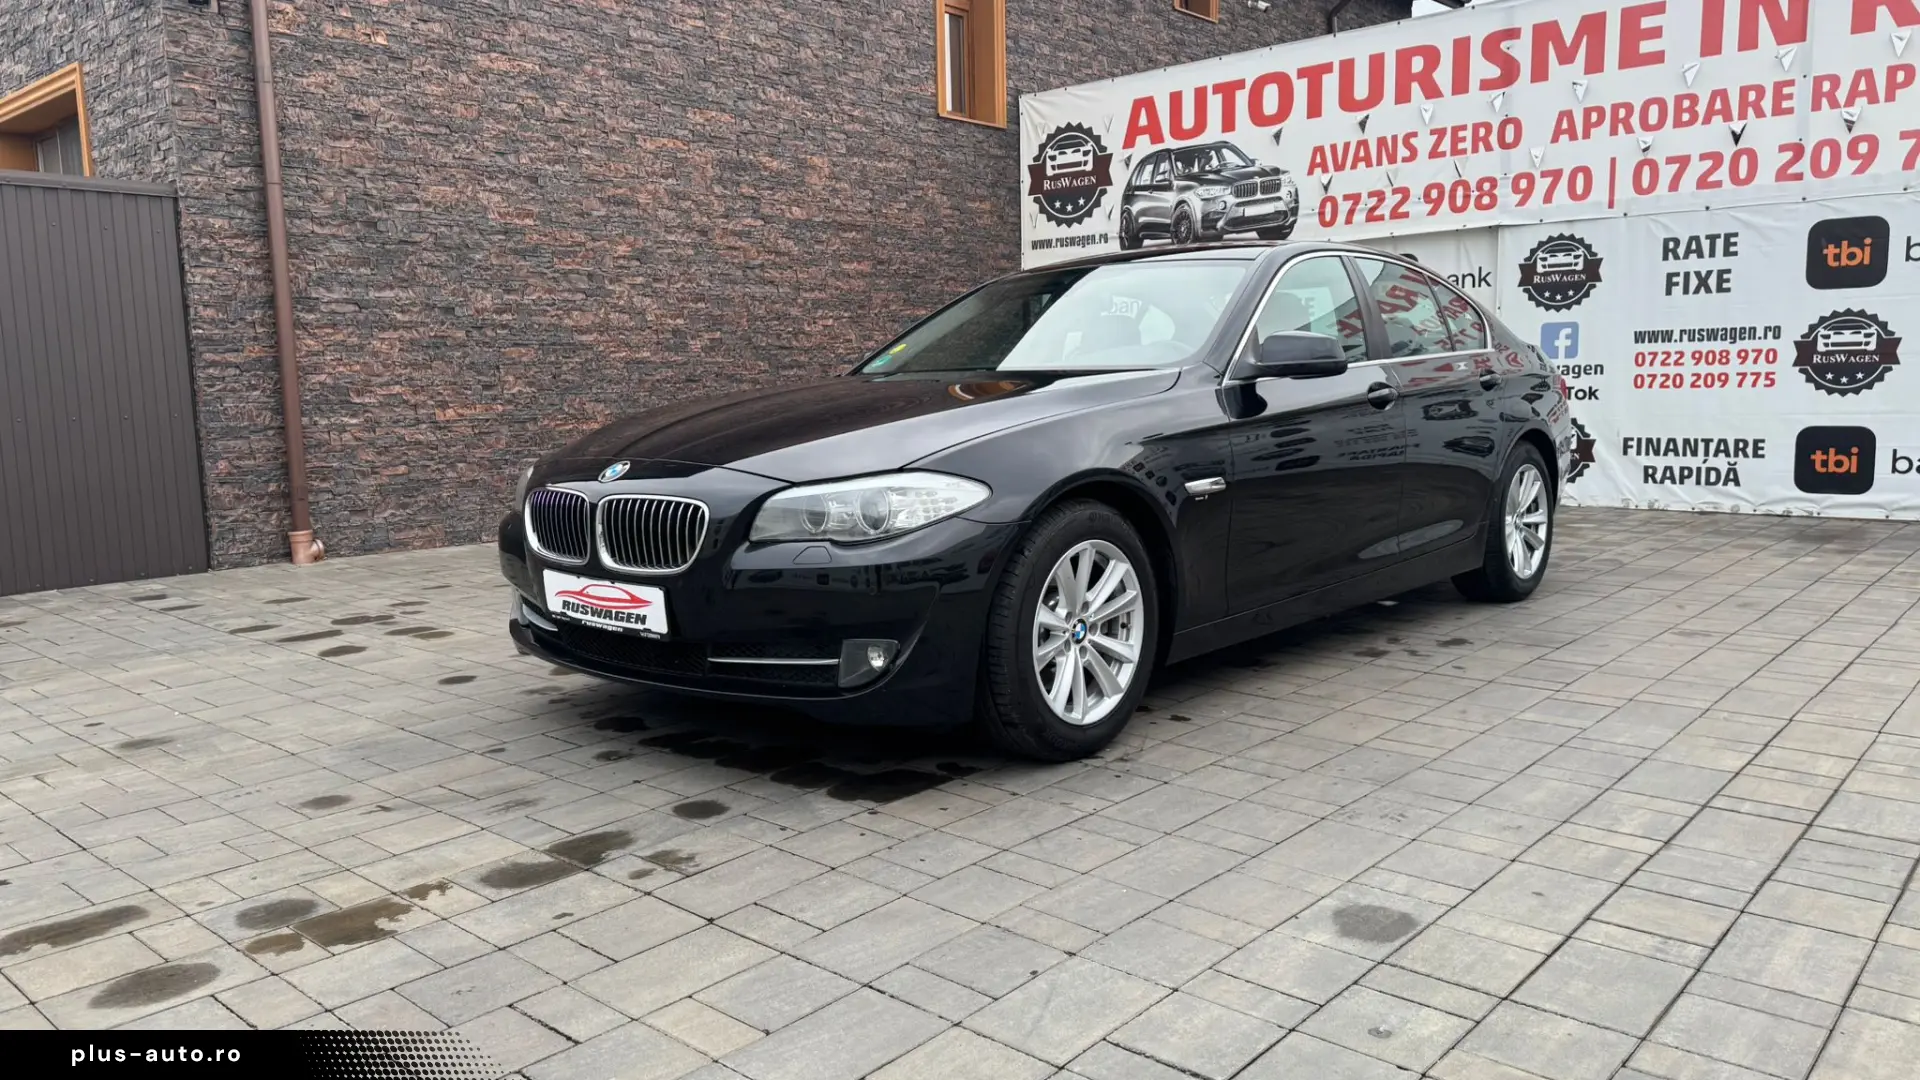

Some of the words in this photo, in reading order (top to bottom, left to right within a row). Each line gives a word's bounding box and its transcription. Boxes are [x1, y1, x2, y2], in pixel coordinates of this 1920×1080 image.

[1122, 1, 1667, 149] AUTOTURISME
[1307, 131, 1418, 176] AVANS
[1428, 117, 1523, 160] ZERO
[1550, 79, 1795, 144] APROBARE
[1811, 63, 1916, 112] RAP
[1318, 187, 1410, 228] 0722
[1423, 176, 1498, 216] 908
[1510, 164, 1594, 208] 970
[1632, 146, 1759, 196] 0720
[1774, 133, 1880, 183] 209
[1031, 233, 1109, 251] www.ruswagen.ro
[1663, 232, 1738, 261] RATE
[1822, 237, 1873, 267] tbi
[1666, 269, 1731, 296] FIXE
[1634, 326, 1781, 344] www.ruswagen.ro
[1557, 363, 1604, 379] agen
[1634, 350, 1685, 368] 0722
[1690, 349, 1731, 366] 908
[1736, 347, 1778, 365] 970
[1633, 373, 1685, 389] 0720
[1689, 372, 1730, 389] 209
[1735, 371, 1776, 388] 775
[1810, 446, 1859, 474] tbi
[1891, 448, 1920, 475] b
[562, 600, 648, 626] RUSWAGEN
